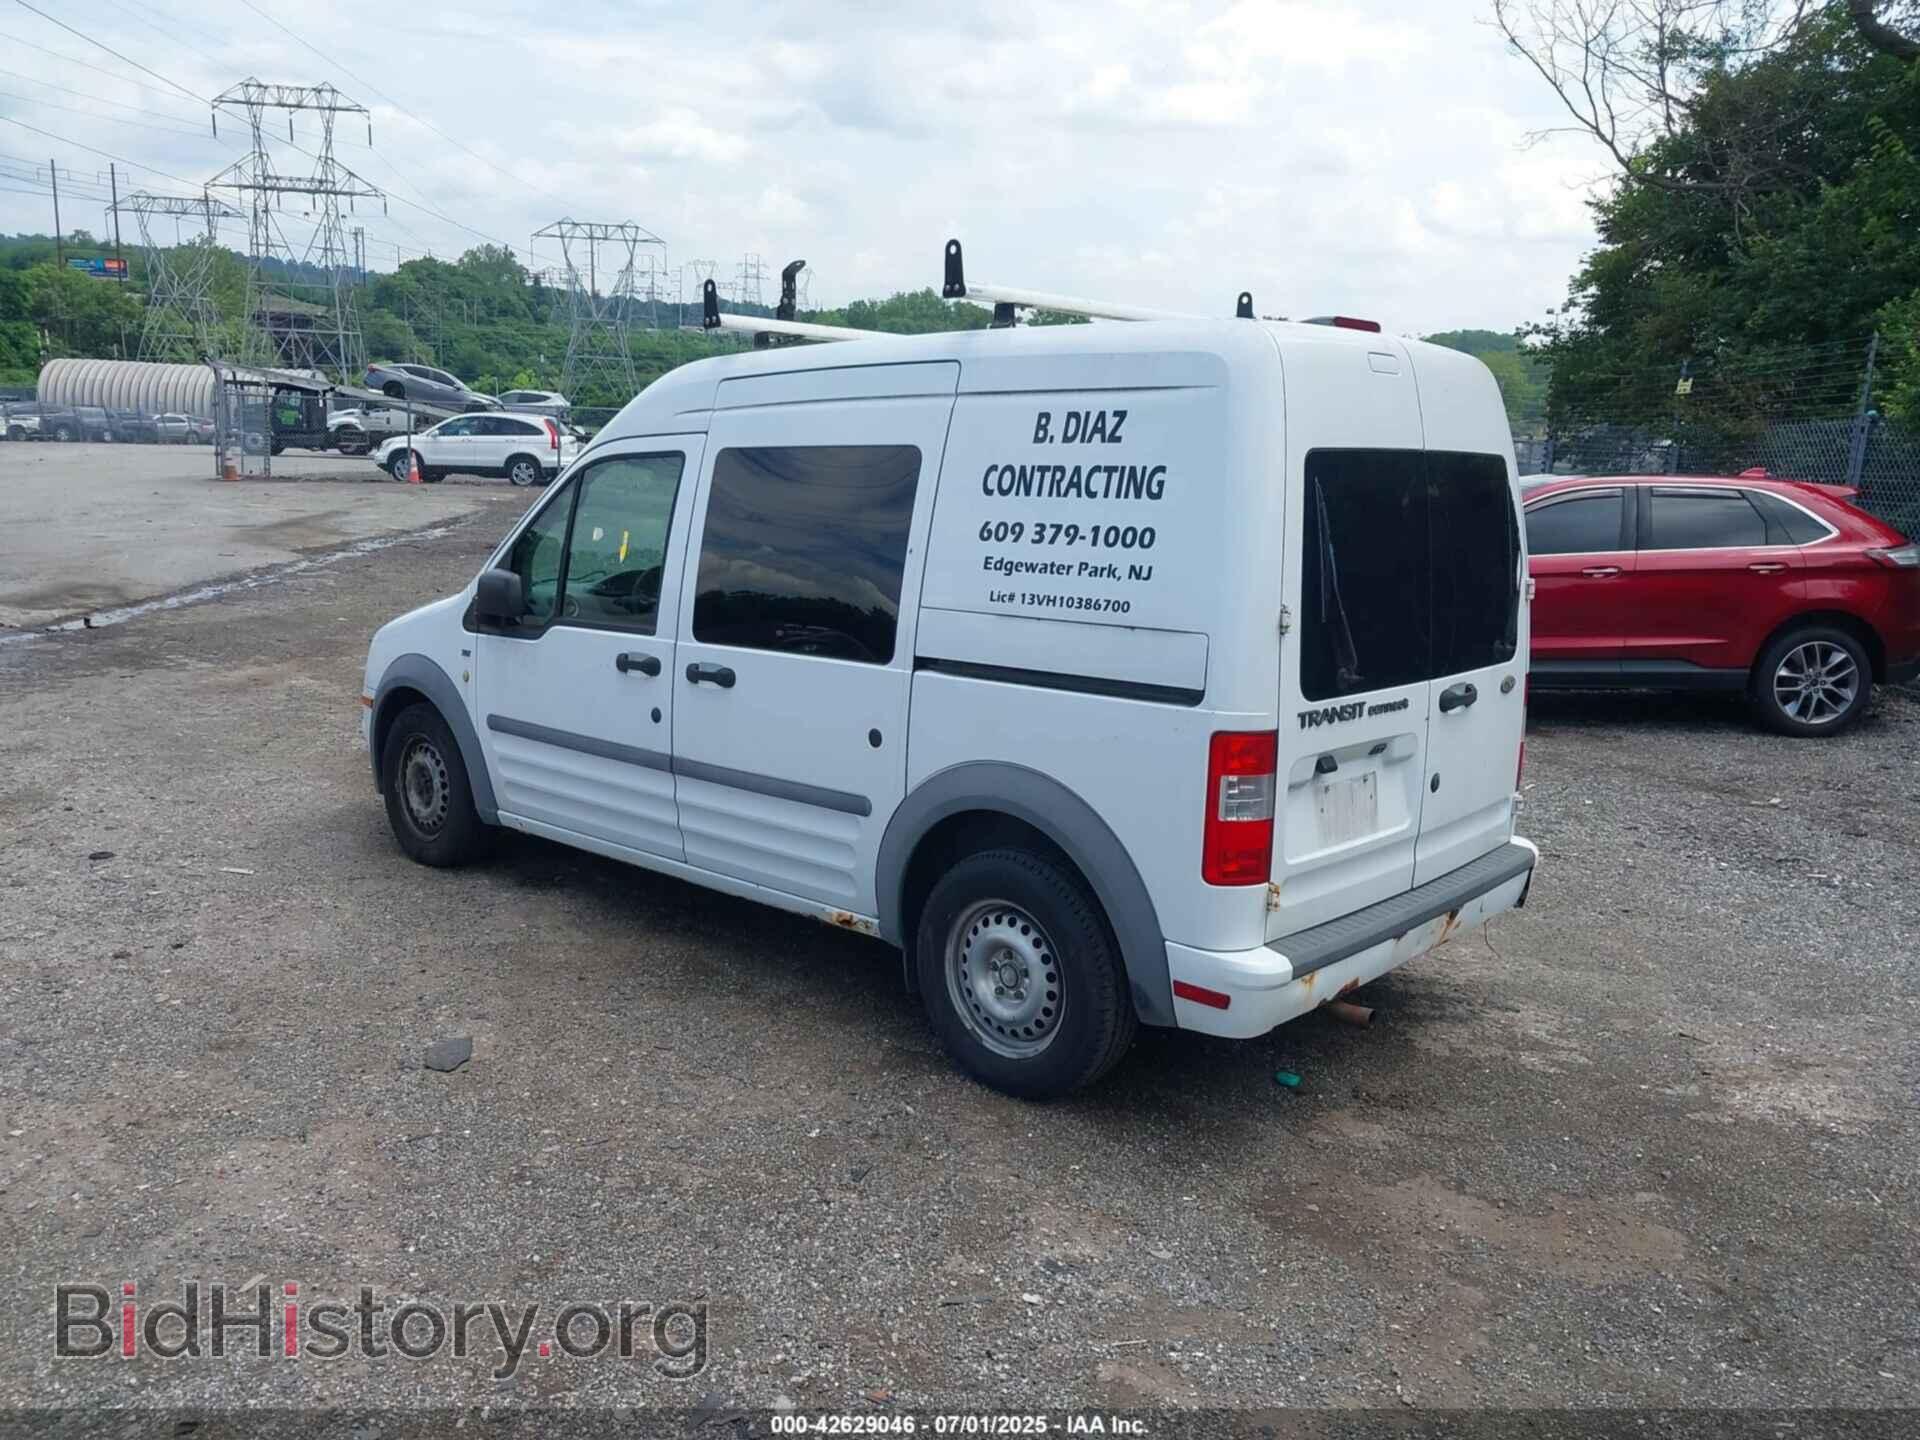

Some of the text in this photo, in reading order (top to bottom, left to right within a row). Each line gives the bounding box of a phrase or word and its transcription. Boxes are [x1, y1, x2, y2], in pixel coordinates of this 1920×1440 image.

[1033, 410, 1128, 444] B. DIAZ
[982, 464, 1167, 500] CONTRACTING
[979, 521, 1156, 549] 609 379-1000
[983, 556, 1153, 582] Edgewater Park, NJ
[989, 591, 1131, 613] Lic# 13VH10386700
[1297, 701, 1367, 730] TRANSIT
